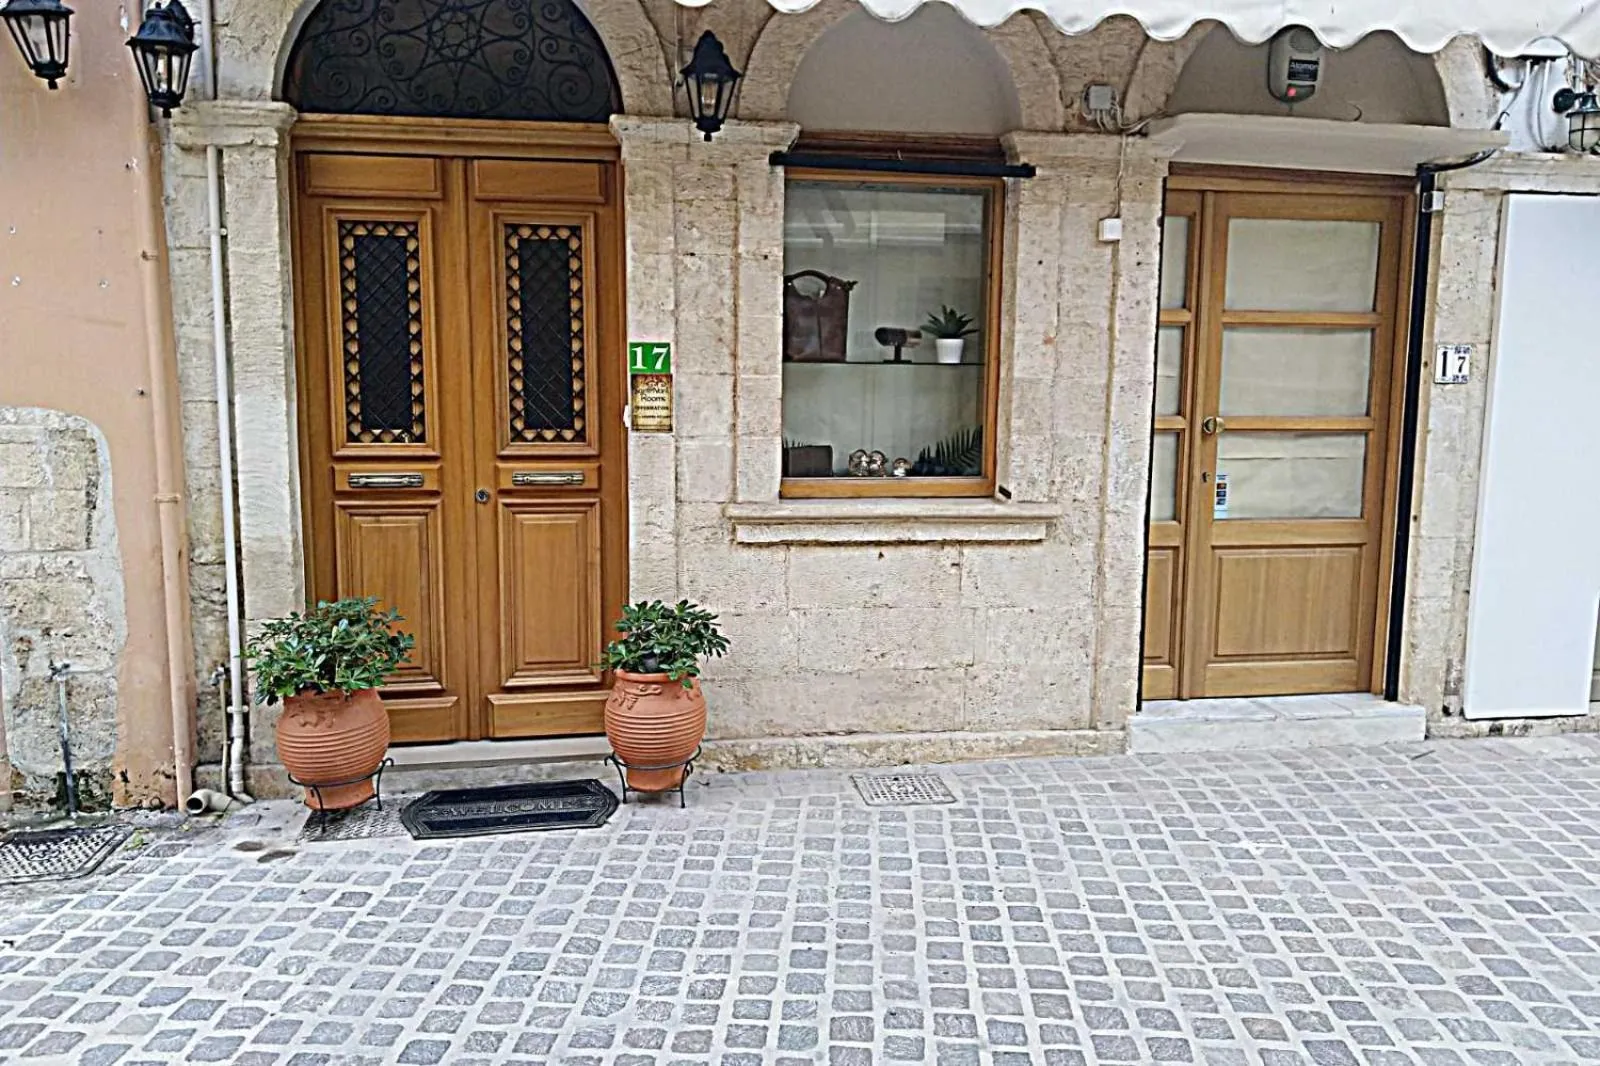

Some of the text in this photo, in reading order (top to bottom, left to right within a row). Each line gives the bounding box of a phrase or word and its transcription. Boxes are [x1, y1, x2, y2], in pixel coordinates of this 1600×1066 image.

[631, 346, 669, 370] 17
[1442, 350, 1467, 377] 17
[448, 799, 573, 817] WELCOME
